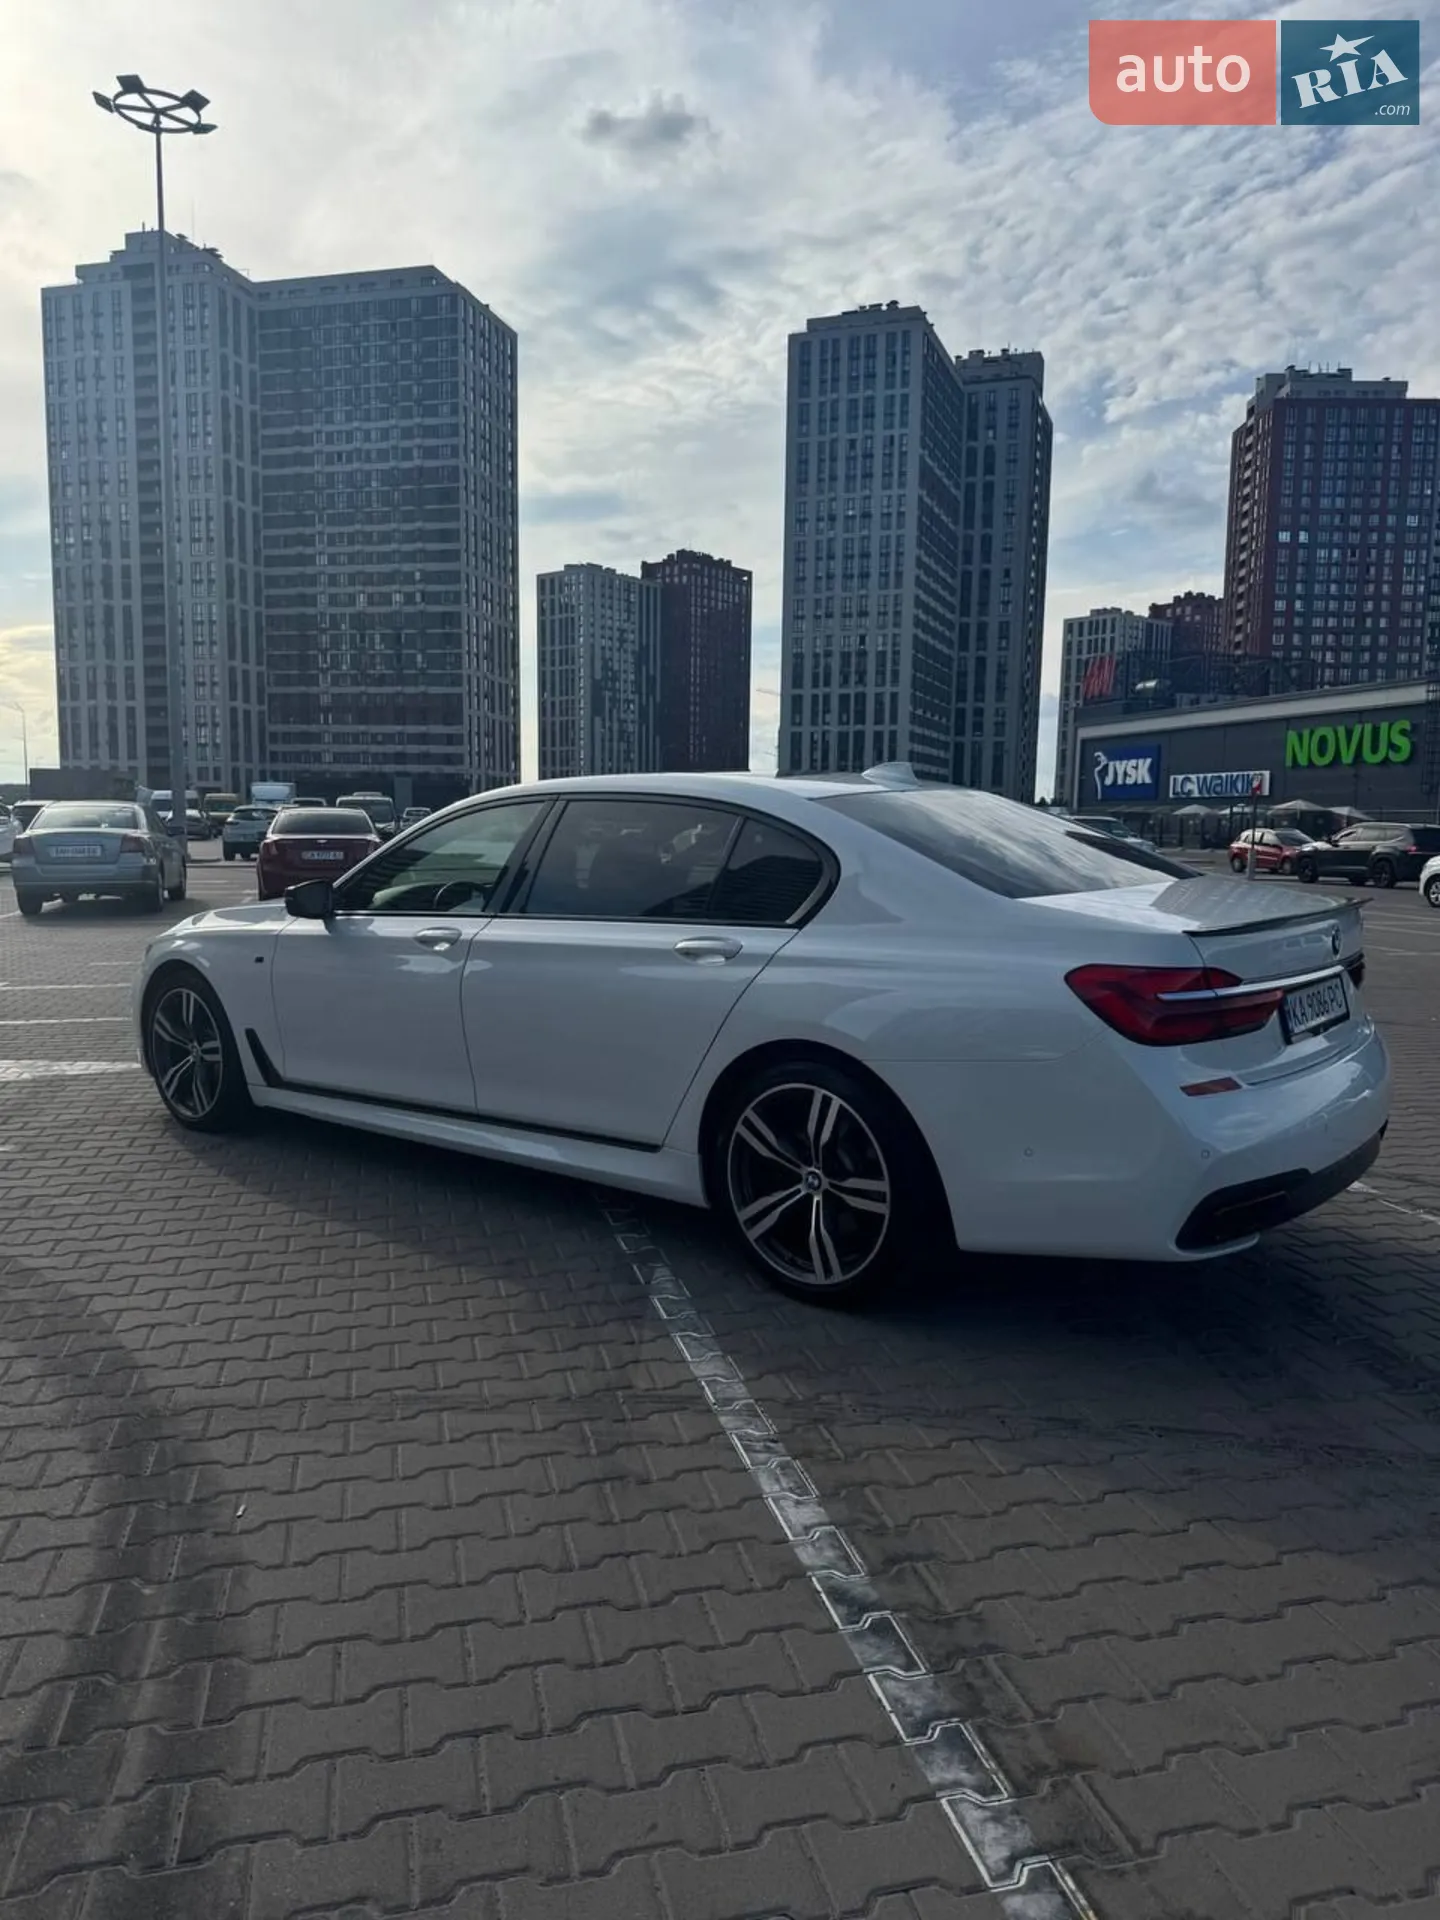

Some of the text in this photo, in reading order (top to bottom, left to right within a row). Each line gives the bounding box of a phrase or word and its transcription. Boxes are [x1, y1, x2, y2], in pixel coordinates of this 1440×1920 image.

[1285, 719, 1411, 768] NOVUS
[1104, 757, 1153, 786] JYSK
[1172, 776, 1195, 796] LC
